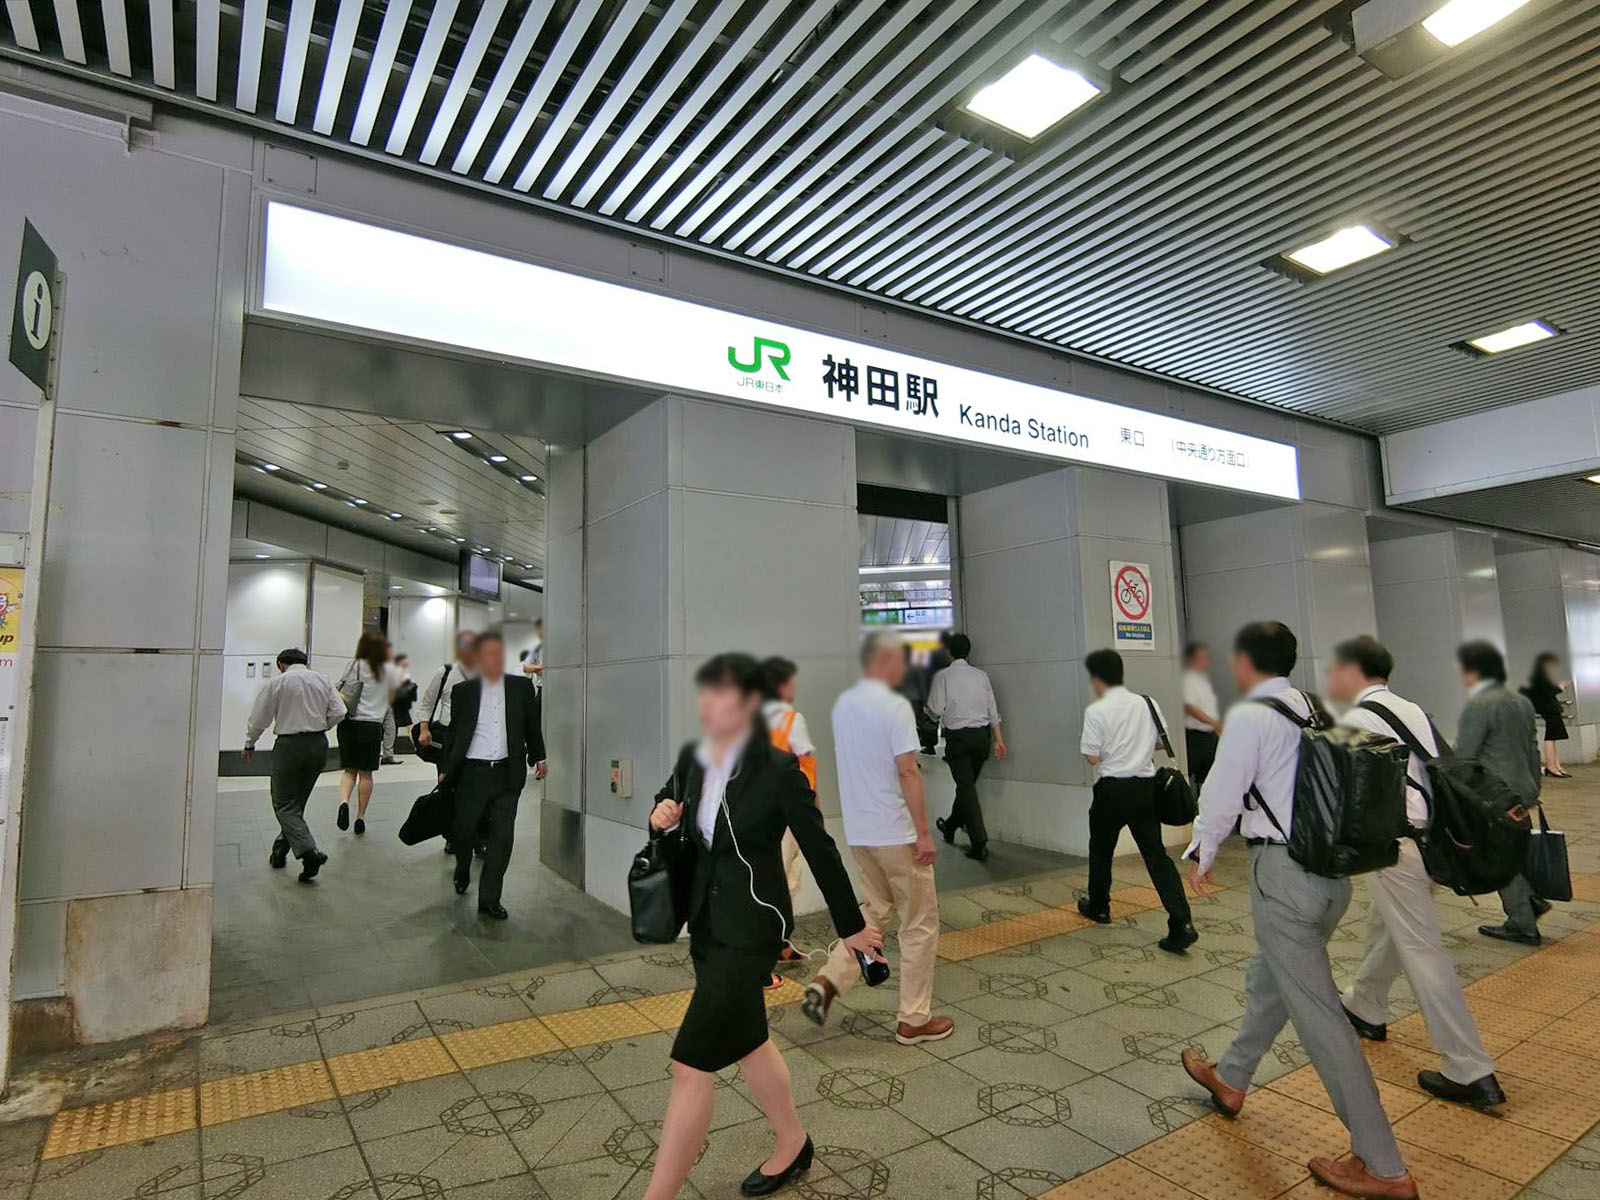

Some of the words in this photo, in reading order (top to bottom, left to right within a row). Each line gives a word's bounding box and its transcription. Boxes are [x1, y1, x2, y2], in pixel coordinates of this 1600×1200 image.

[728, 337, 791, 382] JR
[736, 376, 784, 394] JR東日本
[822, 354, 938, 418] 神田駅
[959, 403, 1020, 435] Kanda
[1028, 418, 1090, 449] Station
[1119, 427, 1145, 448] 東口
